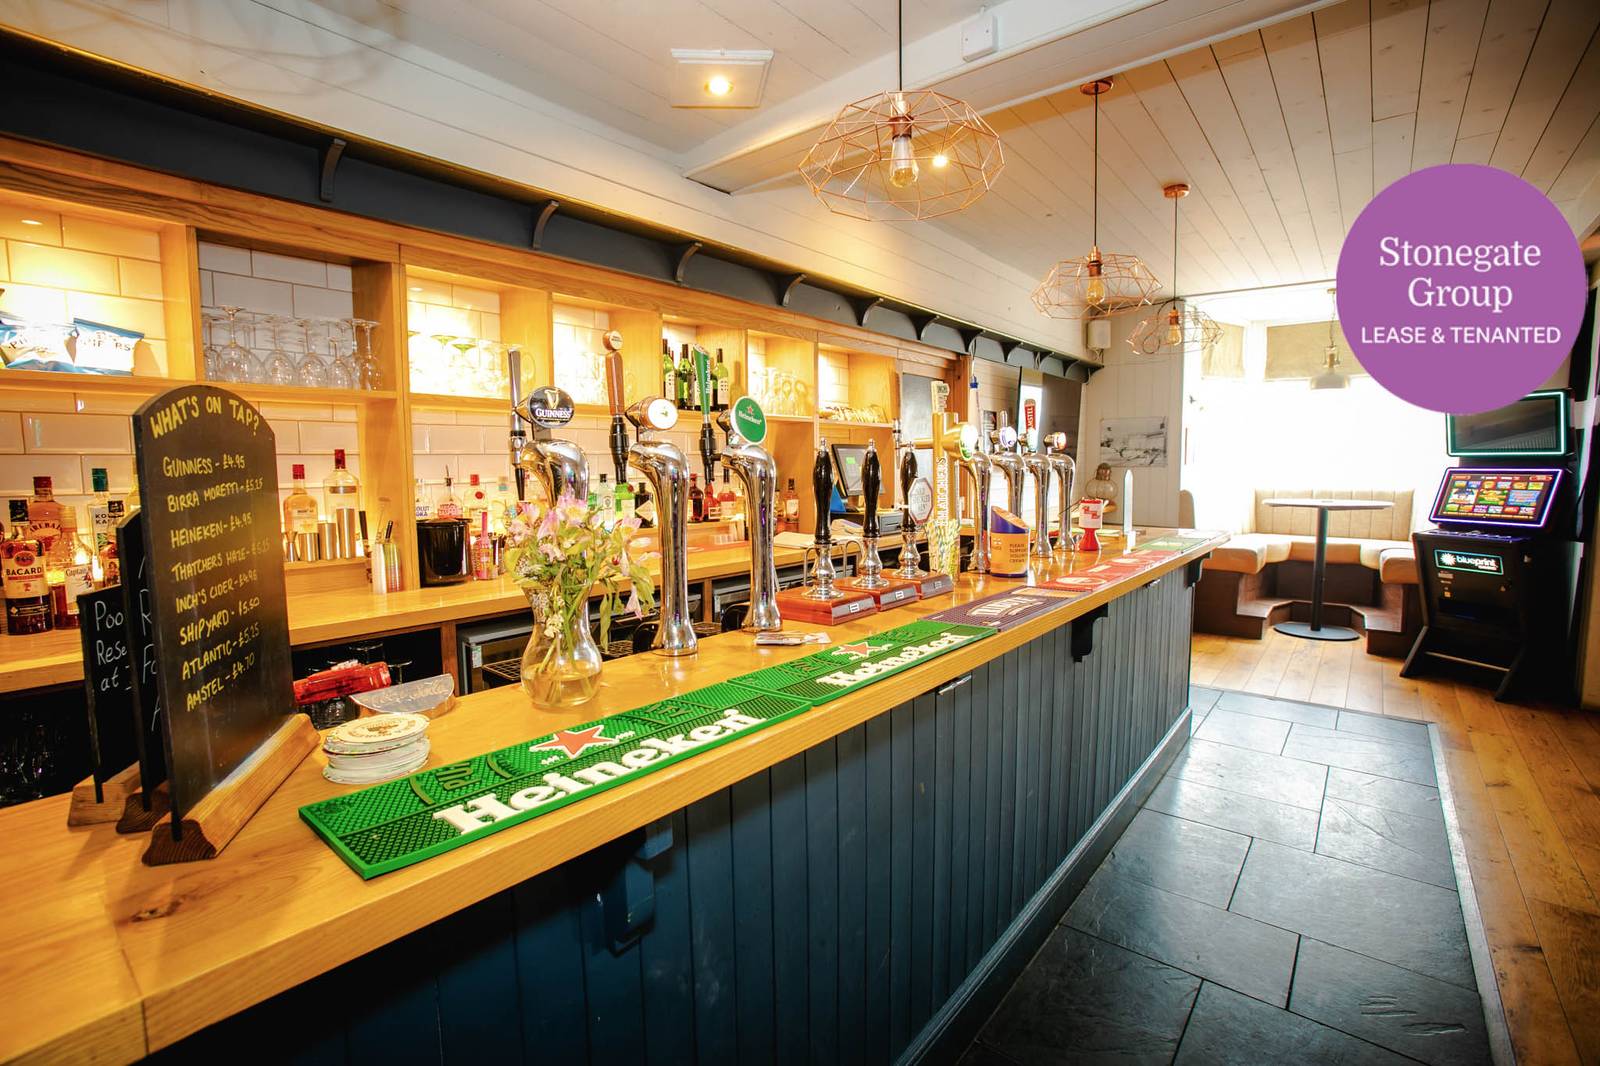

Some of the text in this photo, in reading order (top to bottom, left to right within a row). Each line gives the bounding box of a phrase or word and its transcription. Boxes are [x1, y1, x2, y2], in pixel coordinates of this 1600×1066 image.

[150, 396, 260, 439] WHAT'S ON TAP?
[535, 407, 571, 418] GUINNESS
[163, 456, 213, 477] GUINNESS
[223, 454, 246, 470] £4.95
[167, 490, 200, 513] BIRRA
[204, 481, 240, 503] MORETTI
[170, 520, 223, 548] HEINEKEN
[230, 512, 253, 531] £4.95
[6, 567, 42, 576] BACARD
[171, 552, 223, 582] THATCHERS
[1456, 555, 1497, 567] blueprint
[175, 588, 207, 614] INCH'S
[209, 578, 235, 599] CIDER
[180, 609, 230, 646] SHIPYARD
[182, 640, 233, 680] ATLANTIC
[816, 632, 974, 687] Heineken
[186, 677, 225, 712] AMSTEL
[433, 708, 768, 835] Heineken
